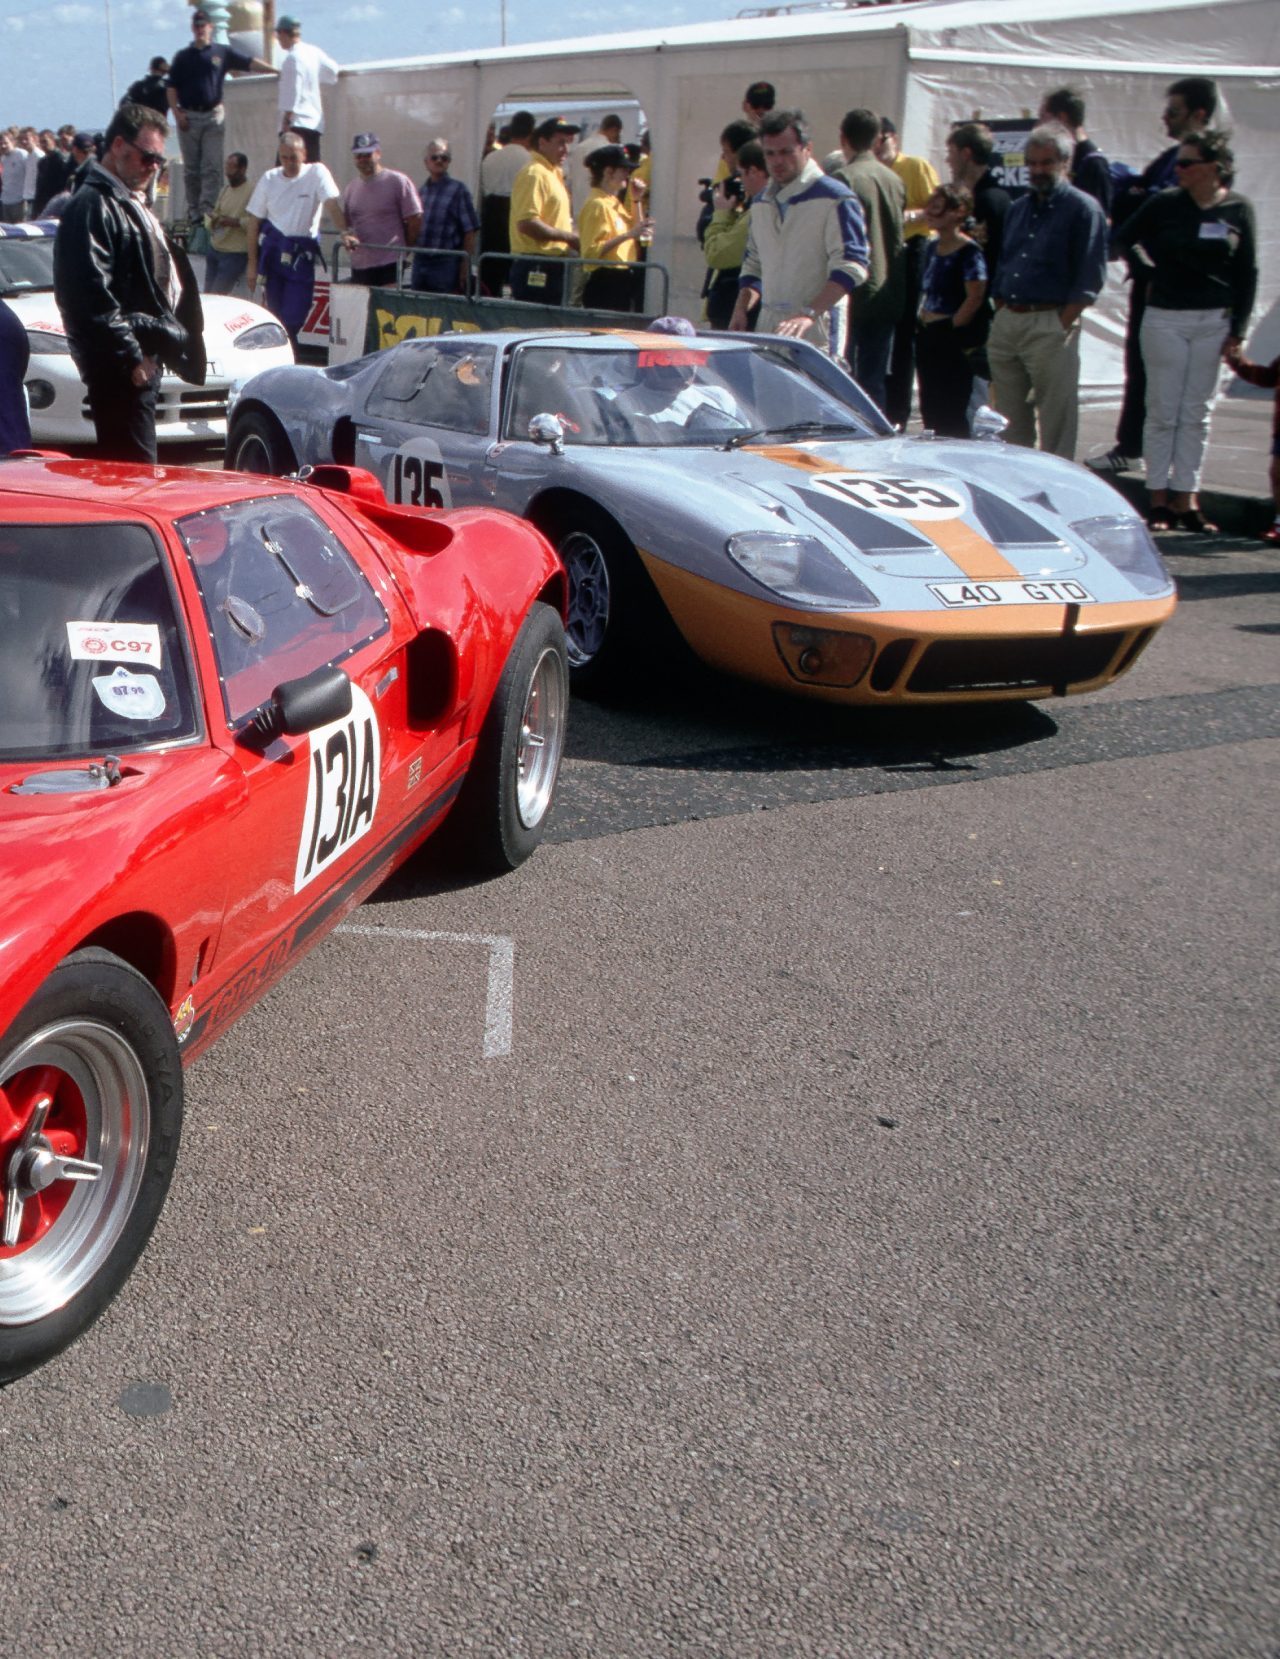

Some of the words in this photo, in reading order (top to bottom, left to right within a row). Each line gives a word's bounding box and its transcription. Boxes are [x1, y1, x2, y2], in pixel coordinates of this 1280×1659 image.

[991, 166, 1030, 187] CKE
[394, 454, 444, 509] 135
[814, 479, 960, 508] 135
[933, 584, 1002, 605] L40
[1021, 582, 1088, 600] GTD
[110, 640, 152, 654] C97
[303, 717, 374, 878] 131A
